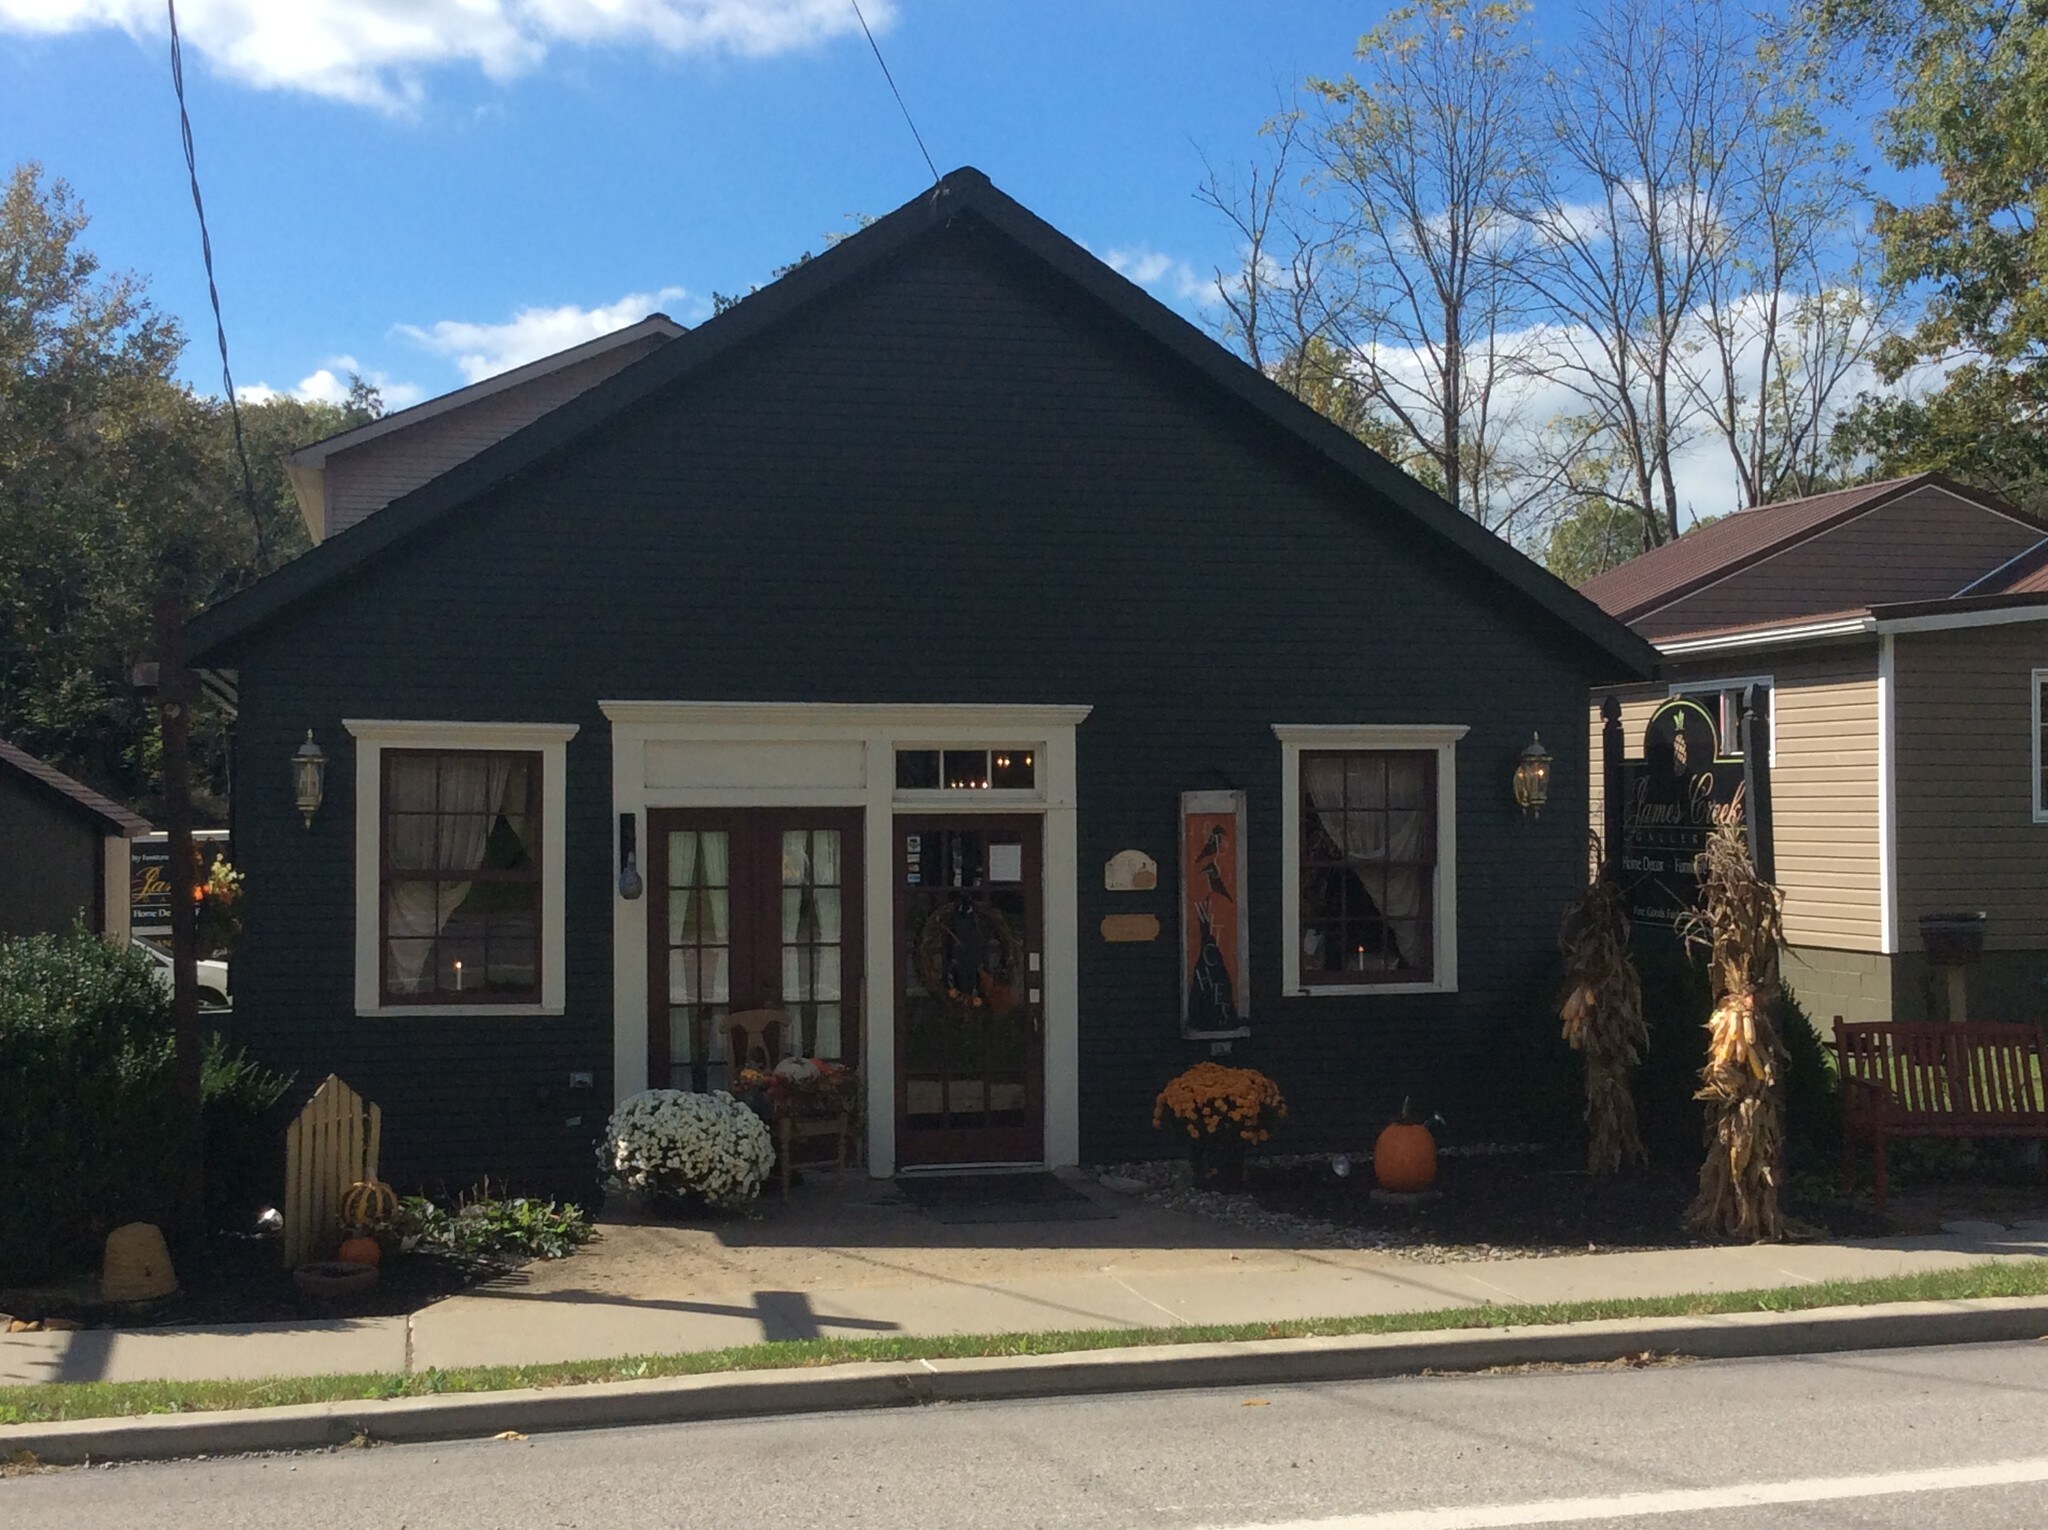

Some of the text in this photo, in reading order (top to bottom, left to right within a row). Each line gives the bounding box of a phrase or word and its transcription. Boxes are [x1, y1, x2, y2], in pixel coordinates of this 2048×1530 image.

[1623, 772, 1747, 838] James Creek
[1635, 832, 1700, 844] GALLER
[1622, 855, 1642, 872] Home
[1642, 856, 1664, 873] Decor
[133, 908, 172, 919] Home De
